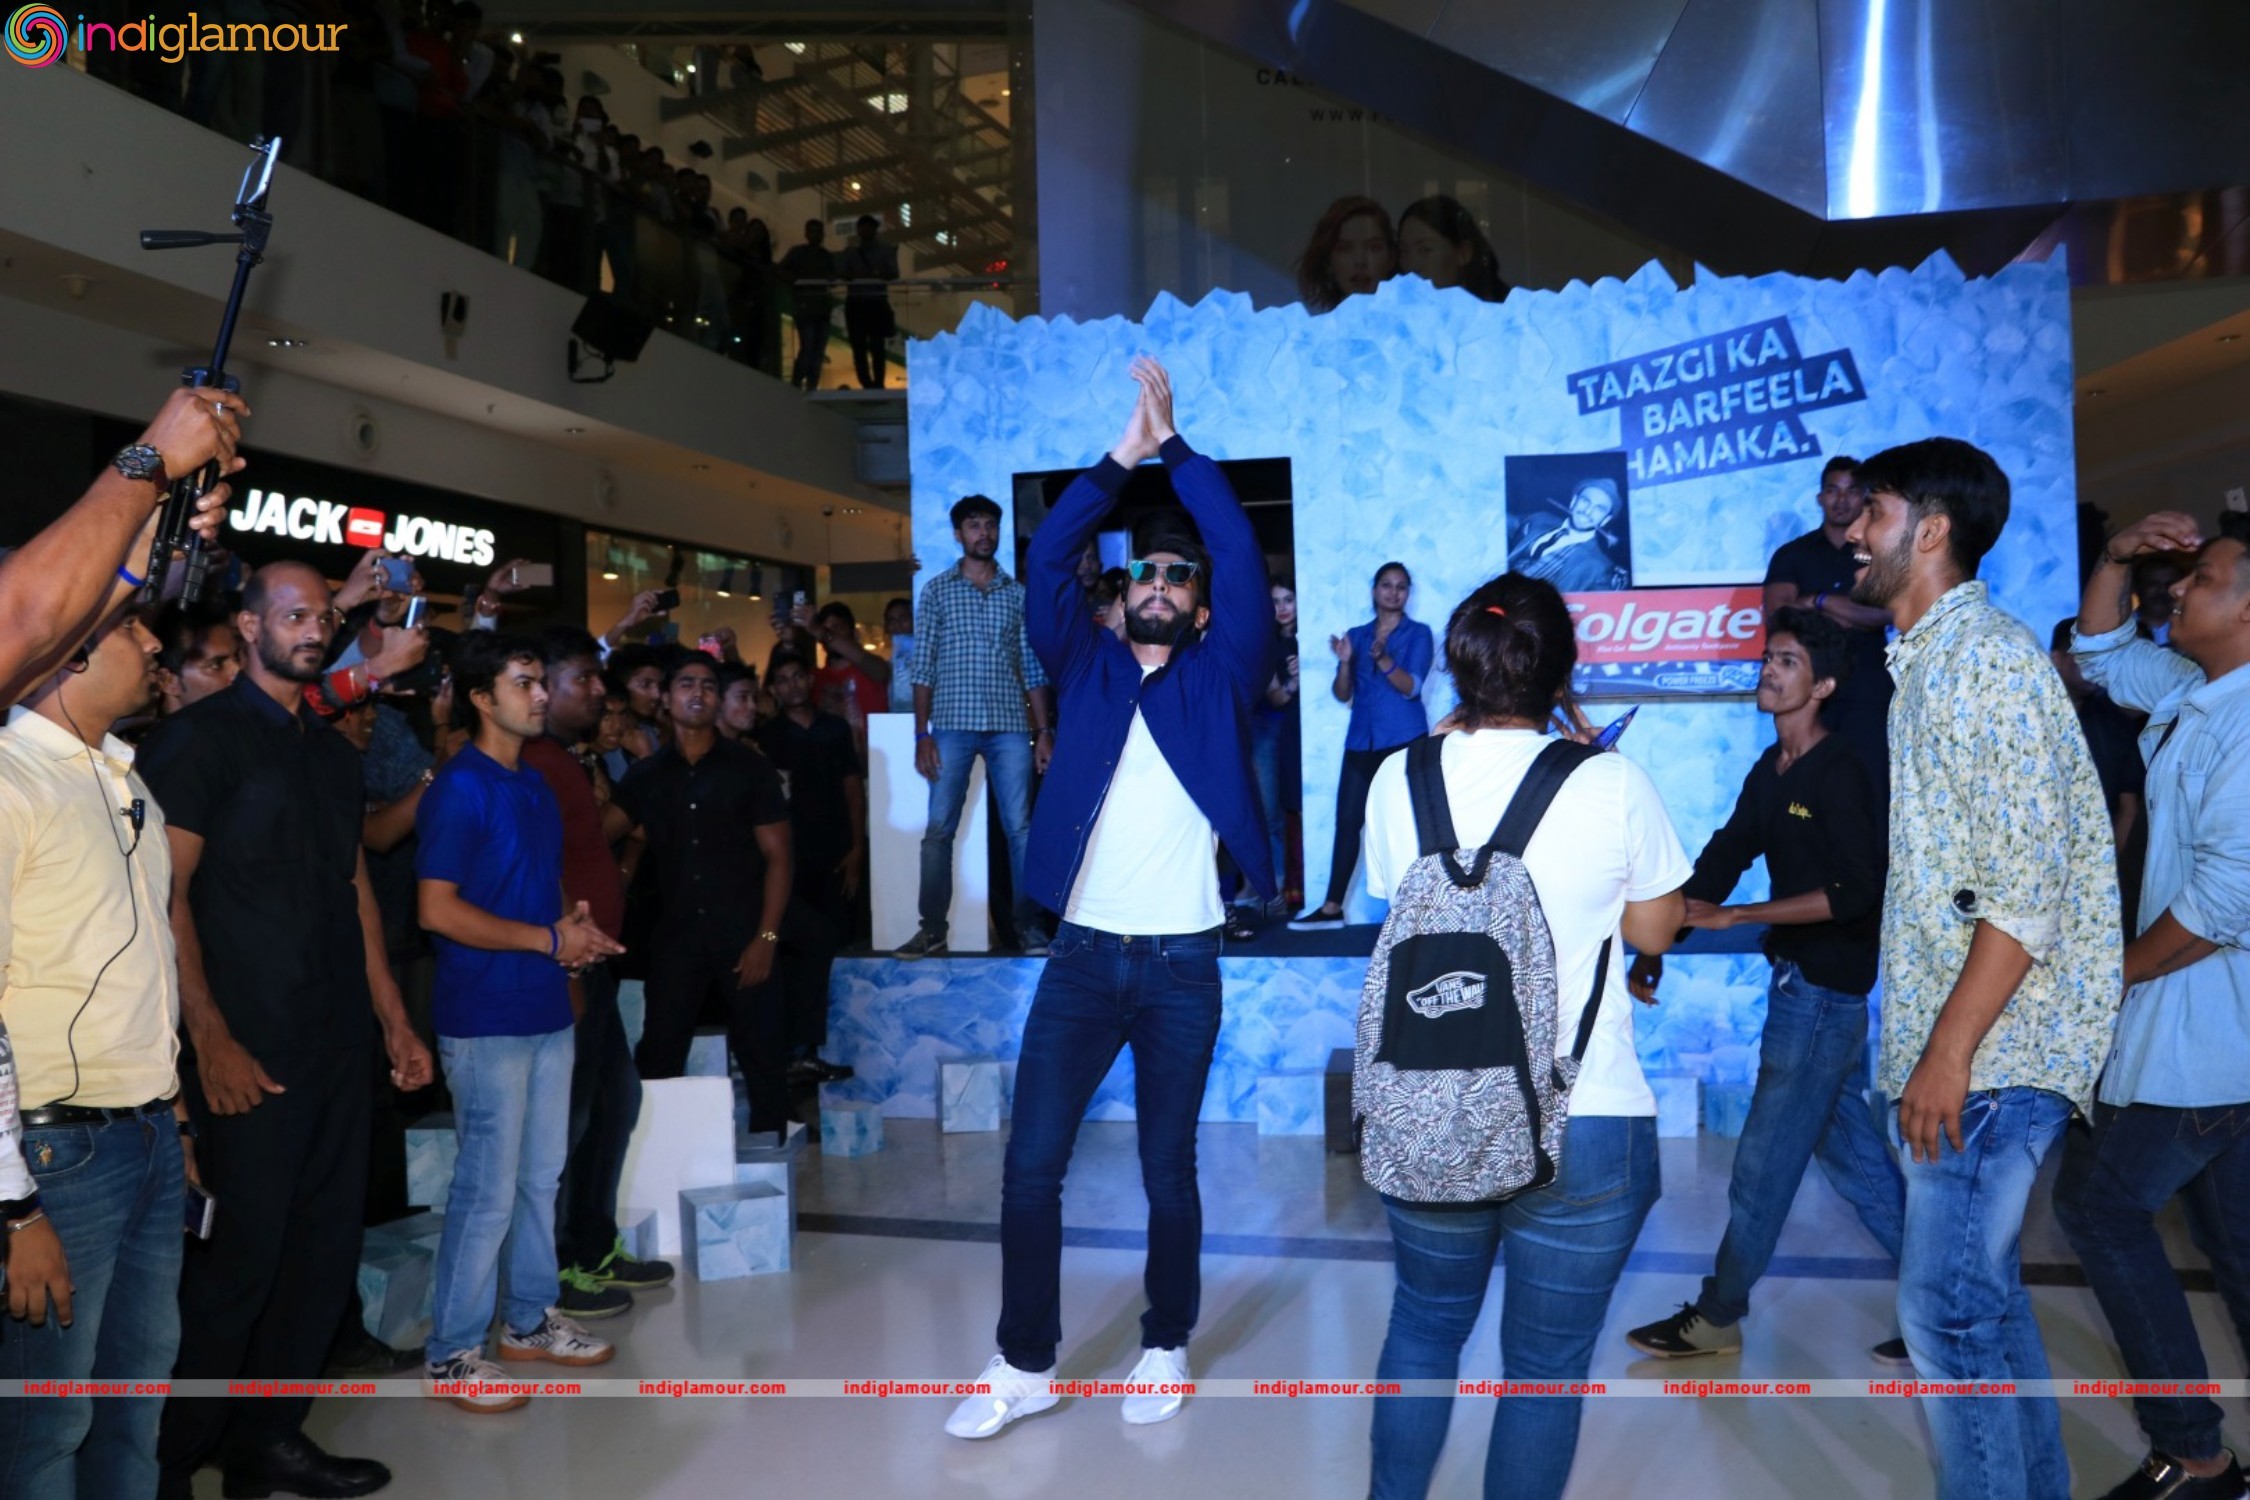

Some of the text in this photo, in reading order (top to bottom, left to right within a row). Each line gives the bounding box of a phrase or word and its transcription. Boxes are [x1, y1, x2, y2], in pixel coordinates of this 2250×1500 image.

[1577, 327, 1789, 408] TAAZGI KA
[1642, 359, 1854, 438] BARFEELA
[229, 489, 495, 567] JACK JONES
[1435, 978, 1463, 994] VANS
[1441, 989, 1460, 1005] THE
